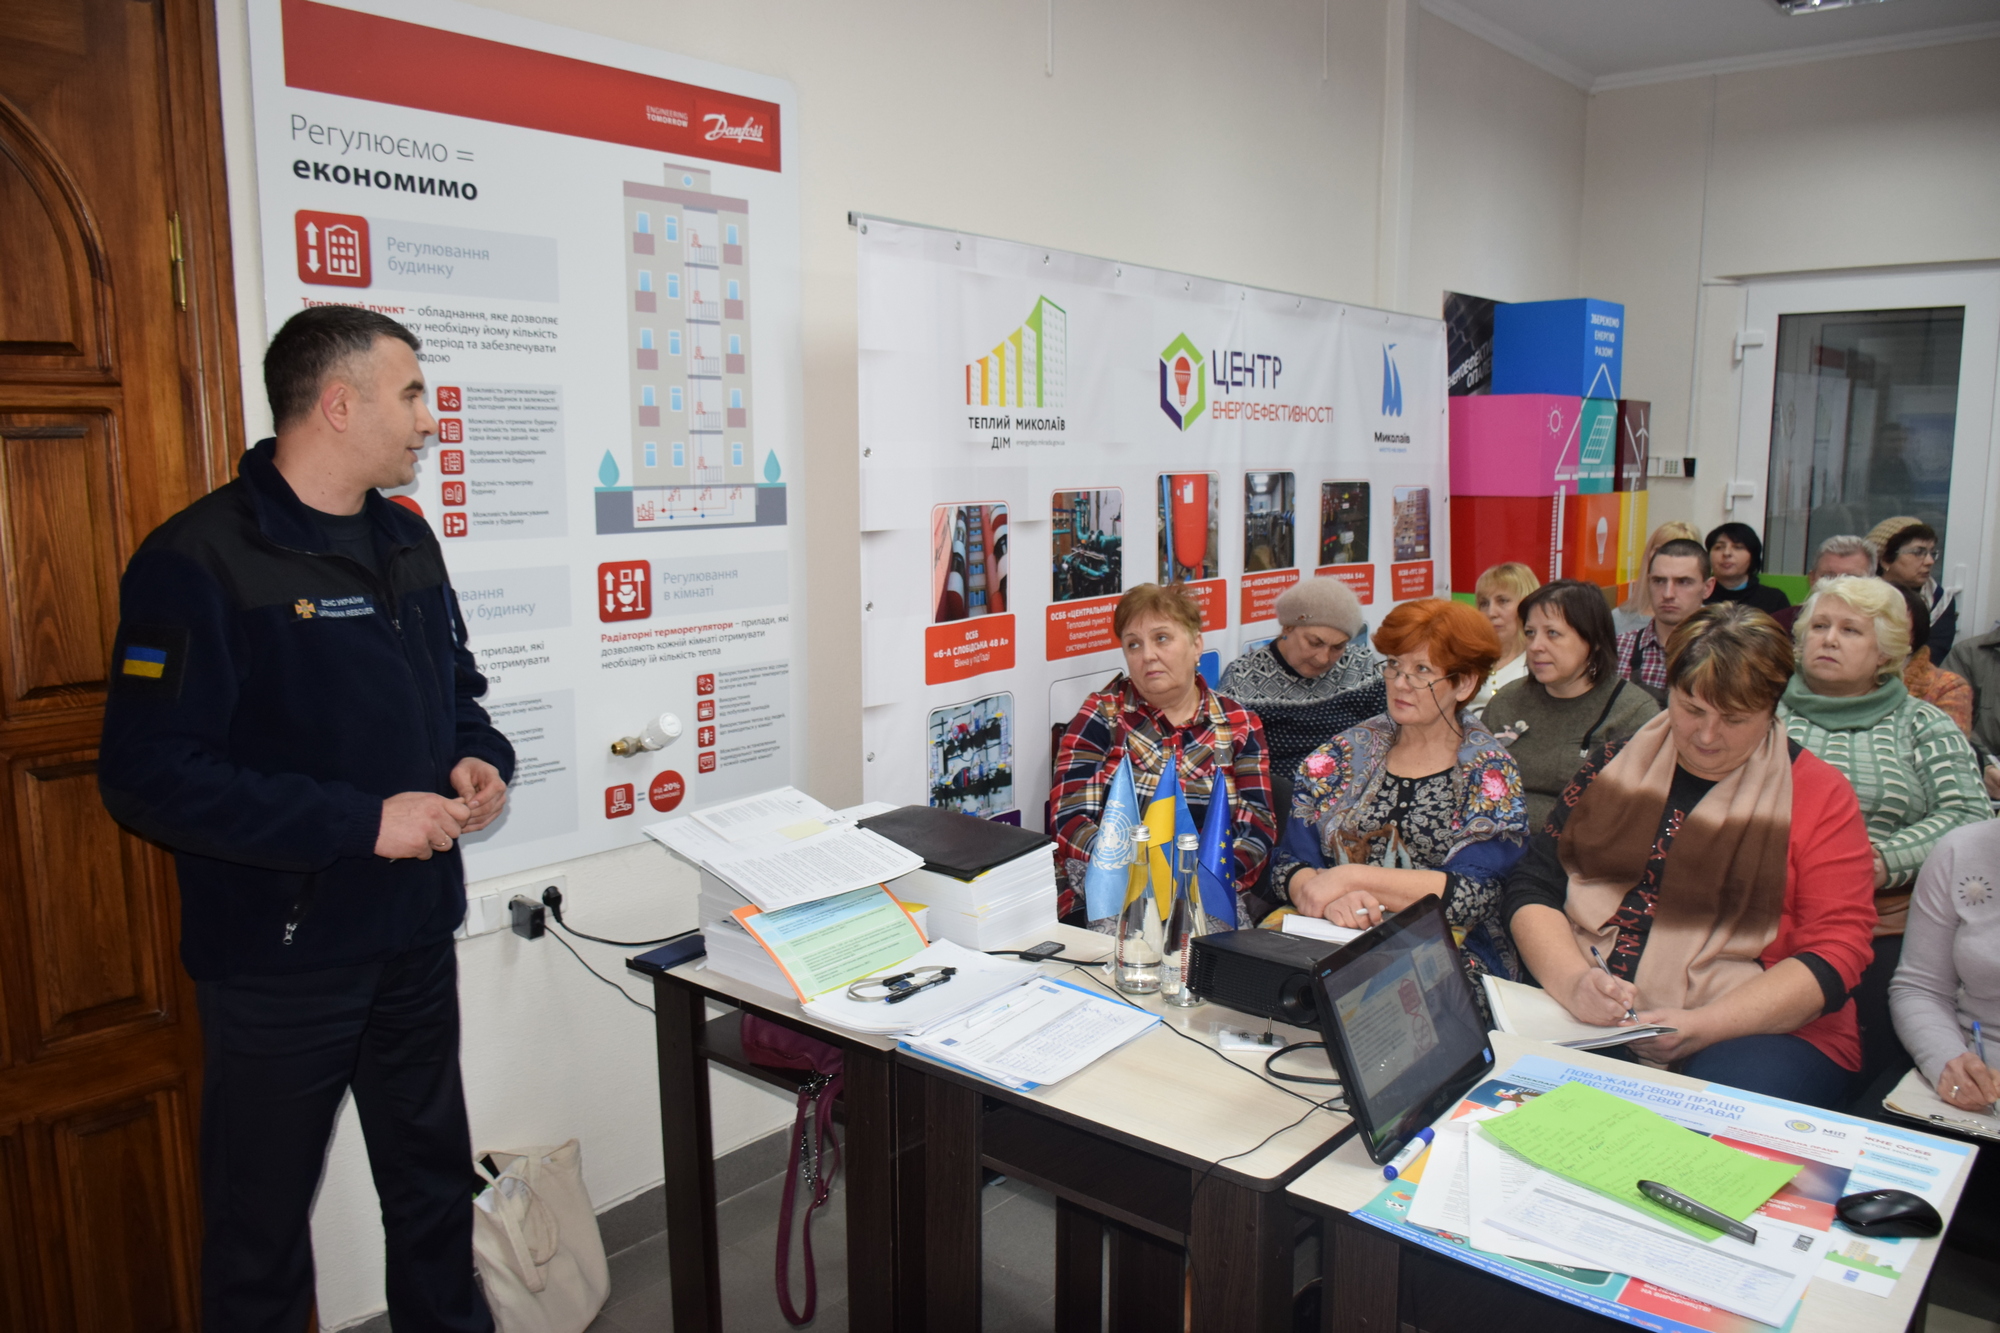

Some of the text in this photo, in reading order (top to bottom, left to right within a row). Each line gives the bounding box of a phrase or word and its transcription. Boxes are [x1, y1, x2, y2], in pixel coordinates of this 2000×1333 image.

[646, 105, 688, 120] ENGINEERING
[646, 113, 688, 127] TOMORROW
[703, 113, 764, 143] Danfoss
[290, 113, 449, 165] Регулюємо
[292, 159, 479, 201] економимо
[386, 236, 490, 263] Регулювання
[387, 257, 454, 279] будинку
[418, 306, 488, 321] обладнання,
[490, 313, 508, 323] яке
[511, 314, 559, 326] дозволяє
[424, 322, 480, 336] необхідну
[483, 325, 510, 338] йому
[512, 327, 558, 340] кількість
[426, 337, 464, 351] період
[467, 340, 479, 349] та
[480, 340, 556, 355] забезпечувати
[1213, 349, 1283, 395] ЦЕНТР
[1212, 400, 1334, 423] ЕНЕРГОЕФЕКТИВНОСТІ
[968, 415, 1066, 431] ТЕПЛИЙ МИКОЛАЇВ
[991, 436, 1011, 450] ДІМ
[1374, 432, 1410, 444] Миколаїв
[663, 568, 738, 585] Регулювання
[664, 585, 714, 600] в кімнаті
[346, 607, 376, 616] RESCUER
[466, 603, 536, 622] у будинку
[1050, 611, 1066, 621] ОСББ
[1067, 603, 1113, 619] «ЦЕНТРАЛЬНИЙ
[601, 613, 789, 643] Радіаторні терморегулятори прилади, які
[1066, 619, 1091, 630] Тепловий
[601, 629, 765, 658] дозволяють кожній кімнаті отримувати
[965, 630, 979, 641] ОСББ
[481, 641, 545, 658] прилади, які
[953, 640, 988, 655] СЛОБІДСЬКА
[490, 655, 550, 672] отримувати
[602, 647, 721, 670] необхідну їй кількість тепла
[663, 782, 681, 792] 20%
[1564, 1068, 1746, 1114] ПОВАЖАЙ СВОЮ ПРАЦЮ
[1646, 1093, 1684, 1107] СВОЇ
[1684, 1101, 1742, 1121] ПРАВА!
[1896, 1143, 1932, 1157] ОСББ
